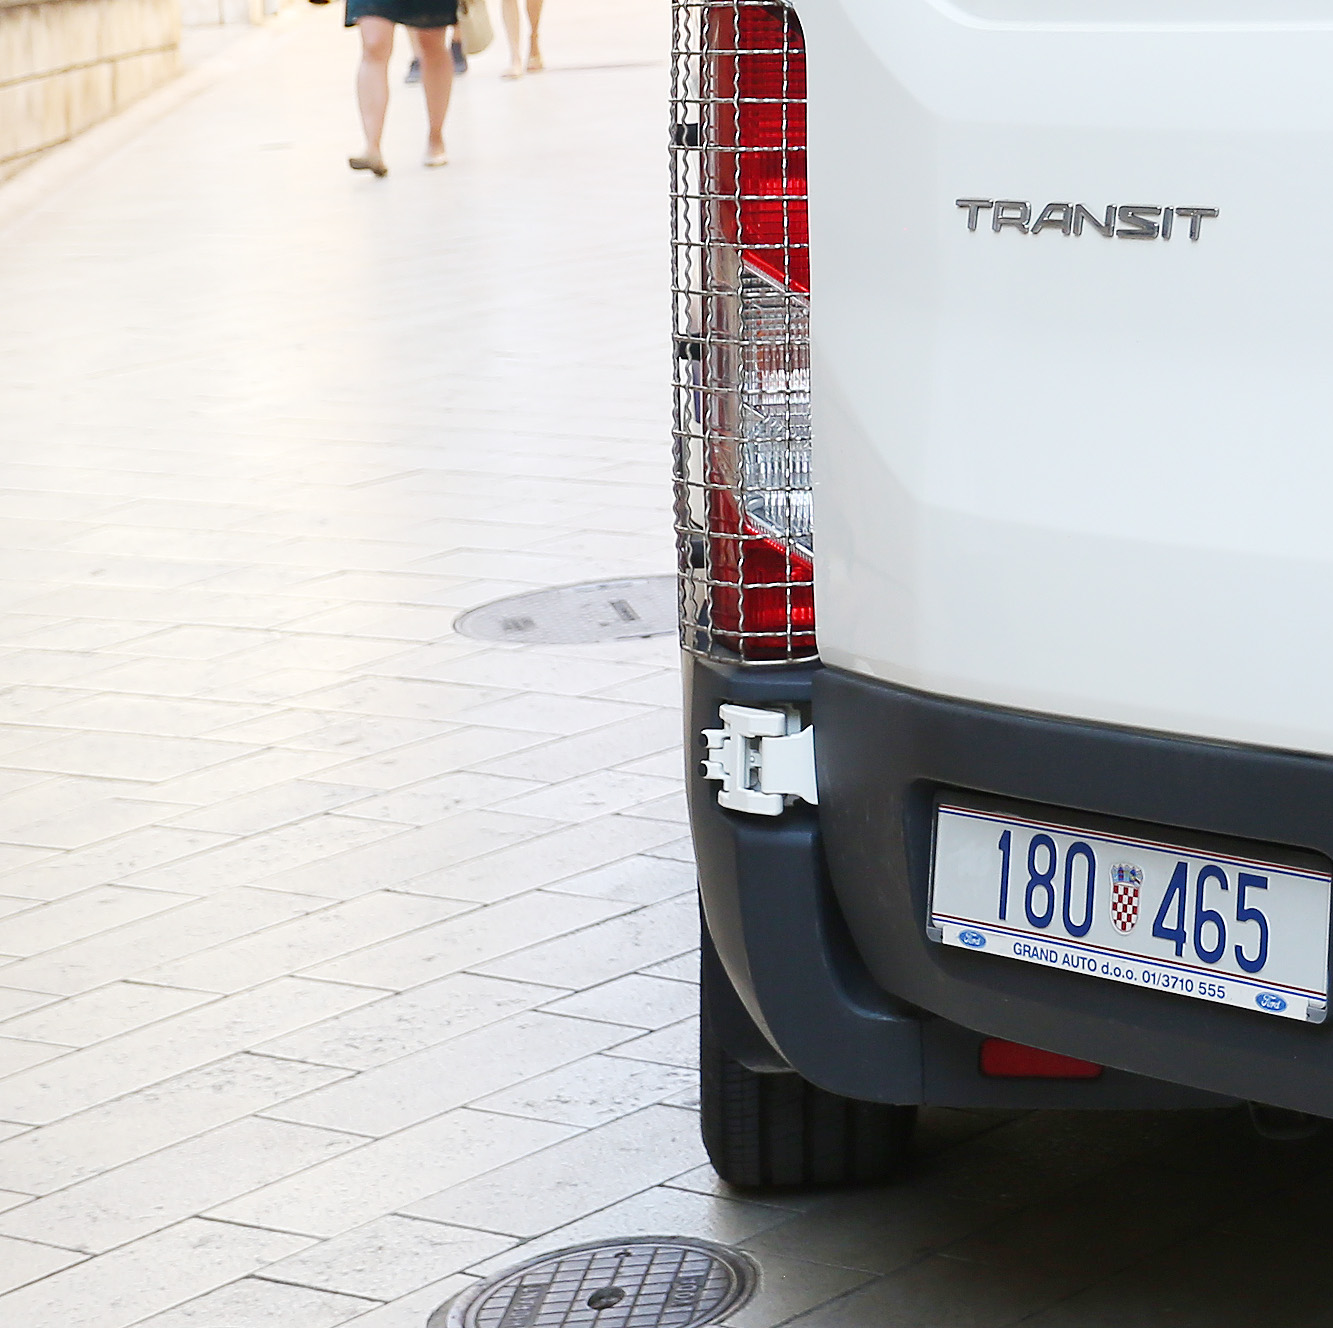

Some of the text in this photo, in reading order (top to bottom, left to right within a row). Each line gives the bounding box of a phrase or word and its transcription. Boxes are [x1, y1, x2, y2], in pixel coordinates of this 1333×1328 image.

[955, 198, 1220, 242] TRANSIT
[998, 829, 1269, 973] 180 465
[962, 930, 984, 947] Ford
[1013, 942, 1226, 1000] GRAND AUTO d.o.o. 01/3710 555
[1259, 993, 1284, 1011] Ford
